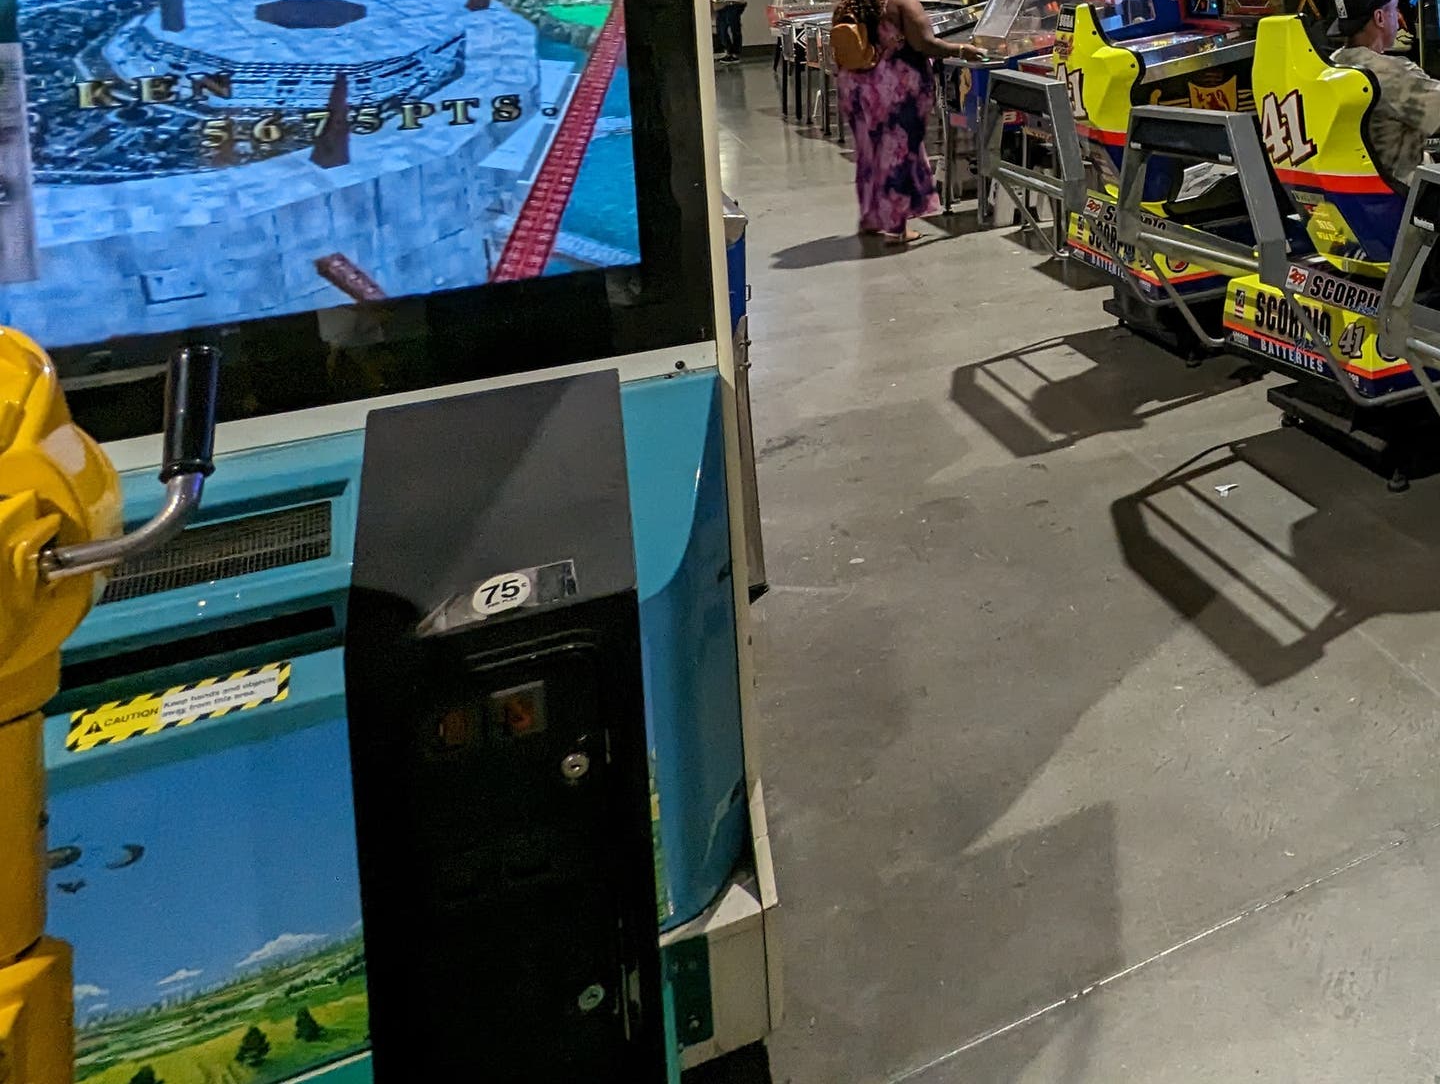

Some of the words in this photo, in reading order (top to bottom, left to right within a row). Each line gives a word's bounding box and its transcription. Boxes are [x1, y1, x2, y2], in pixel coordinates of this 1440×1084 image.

[77, 70, 233, 110] KEN
[1261, 89, 1318, 168] 41
[1260, 339, 1324, 373] BATTERIES
[1338, 322, 1366, 359] 41
[164, 699, 188, 709] Keep
[190, 689, 220, 702] hands
[222, 685, 241, 696] and
[242, 676, 277, 691] objects
[189, 699, 212, 711] from
[214, 694, 232, 705] this
[103, 706, 160, 727] CAUTION
